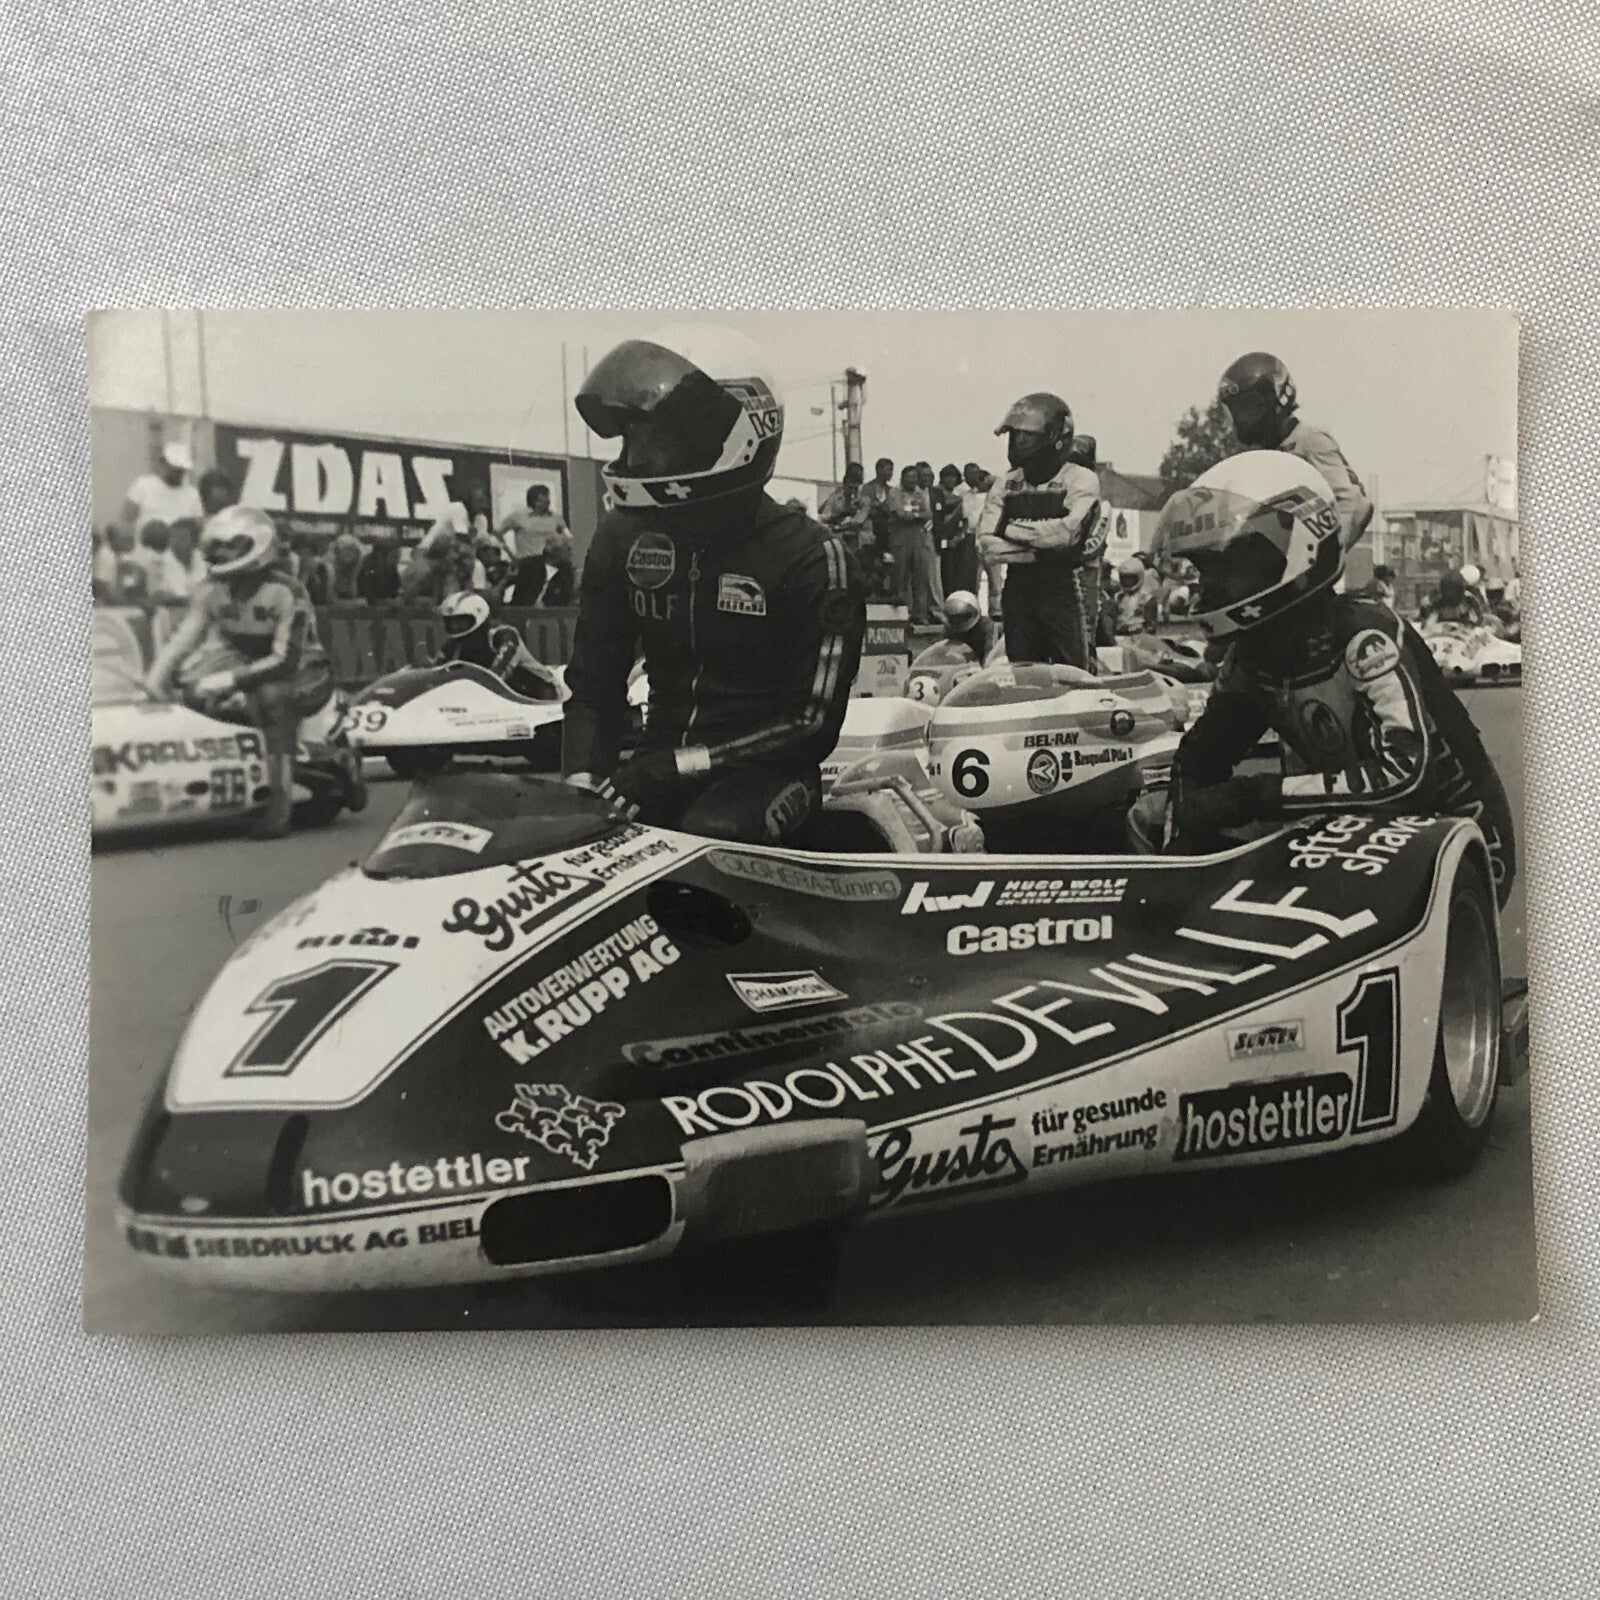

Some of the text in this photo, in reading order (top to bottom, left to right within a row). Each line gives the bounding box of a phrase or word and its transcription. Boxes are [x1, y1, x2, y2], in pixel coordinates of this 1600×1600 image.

[630, 550, 672, 566] Castrol
[1024, 731, 1080, 750] BEL-RAY
[951, 748, 991, 798] 6
[629, 935, 682, 983] AG
[946, 914, 1113, 956] Castrol
[482, 914, 660, 1041] AUTOVERWERTUNG
[744, 982, 826, 1002] CHAMPION
[222, 957, 401, 1078] 1
[1336, 966, 1401, 1136] 1
[660, 1035, 955, 1136] RODOLPHE
[1031, 1108, 1069, 1137] für
[1072, 1087, 1167, 1127] gesunde
[1181, 1084, 1350, 1154] hostettler
[1032, 1123, 1159, 1169] Ernährung
[302, 1152, 532, 1208] hostettler
[364, 1226, 410, 1251] AG
[419, 1217, 482, 1247] BIEL
